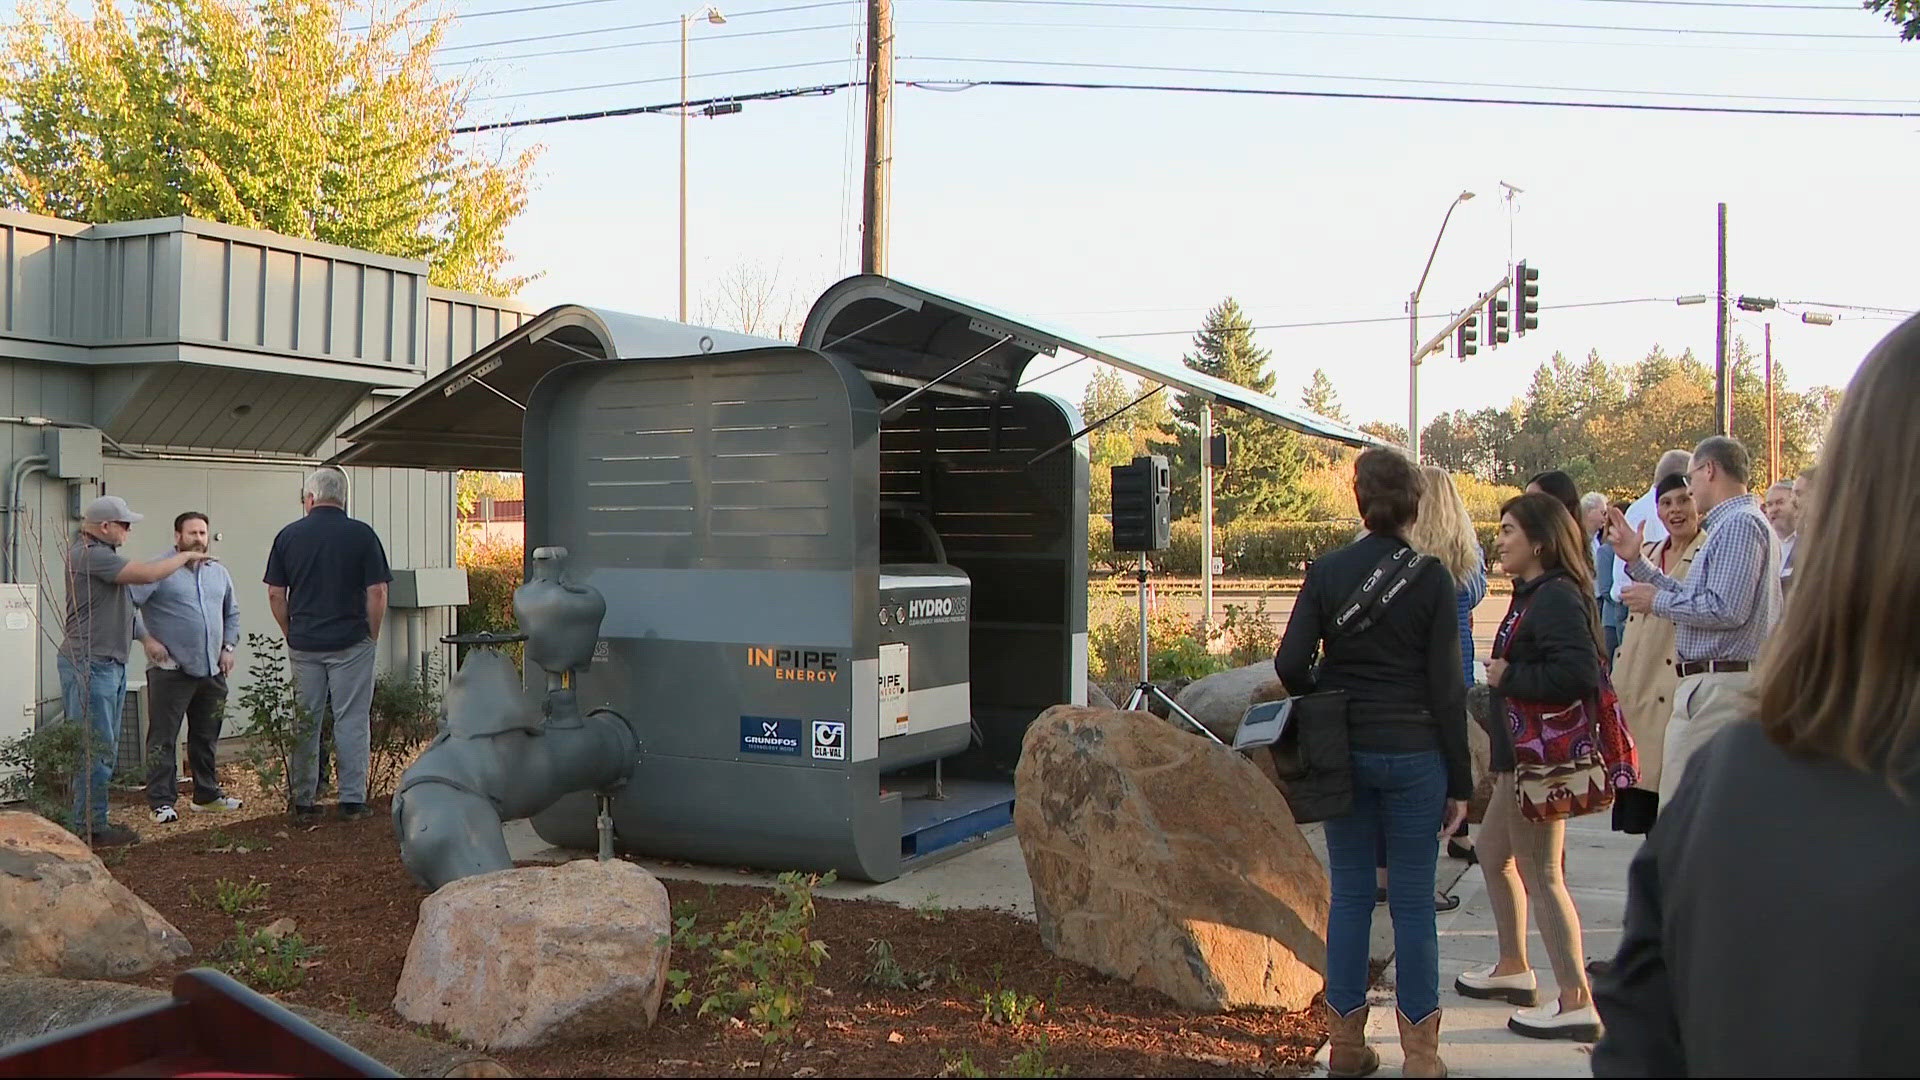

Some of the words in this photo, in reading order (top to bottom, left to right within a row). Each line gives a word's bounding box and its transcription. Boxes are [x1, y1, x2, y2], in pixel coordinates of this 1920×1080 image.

[1382, 578, 1408, 603] Canon
[747, 647, 837, 670] INPIPE
[775, 668, 837, 682] ENERGY
[744, 736, 797, 747] GRUNDFOS
[815, 747, 842, 758] CLA-VAL
